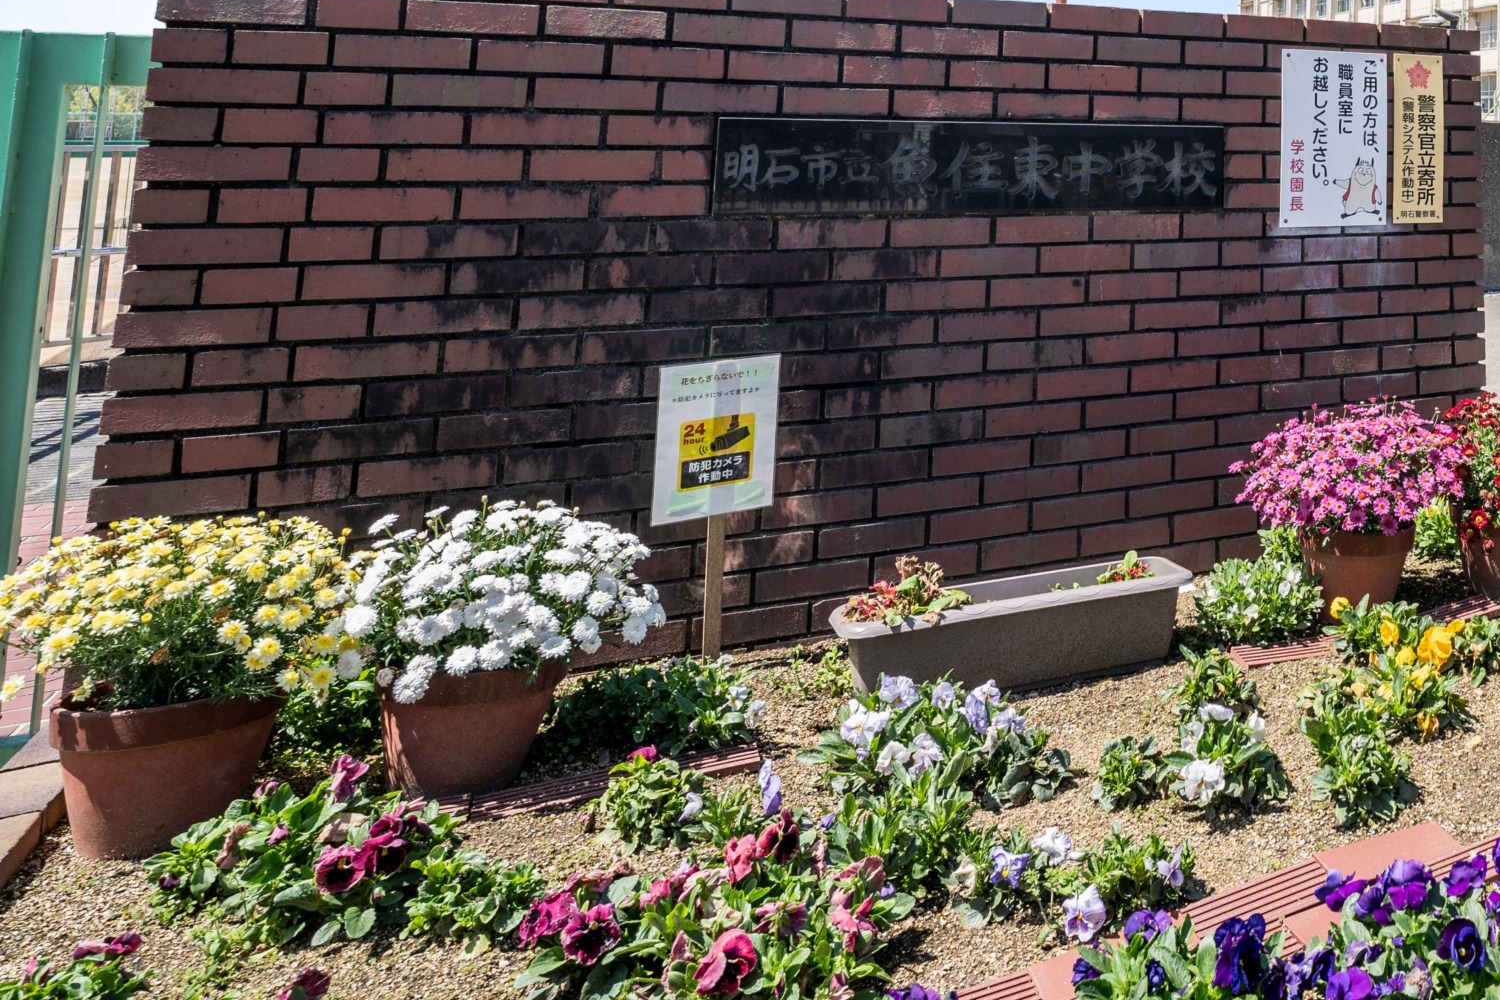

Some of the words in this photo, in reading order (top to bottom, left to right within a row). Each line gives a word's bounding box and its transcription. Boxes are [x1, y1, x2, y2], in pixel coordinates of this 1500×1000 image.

[1312, 57, 1329, 187] お越しください。
[1338, 63, 1354, 135] 職員室に
[1363, 60, 1379, 153] ご用の方は、
[722, 134, 1218, 199] 明石市立魚住東中学校
[1290, 140, 1304, 212] 学校園長
[1417, 94, 1436, 206] 警察官立寄所
[1400, 210, 1436, 218] 明石警察署
[683, 422, 706, 438] 24
[683, 436, 705, 445] hour
[688, 454, 743, 474] 防犯カメラ
[698, 470, 733, 484] 作動中
